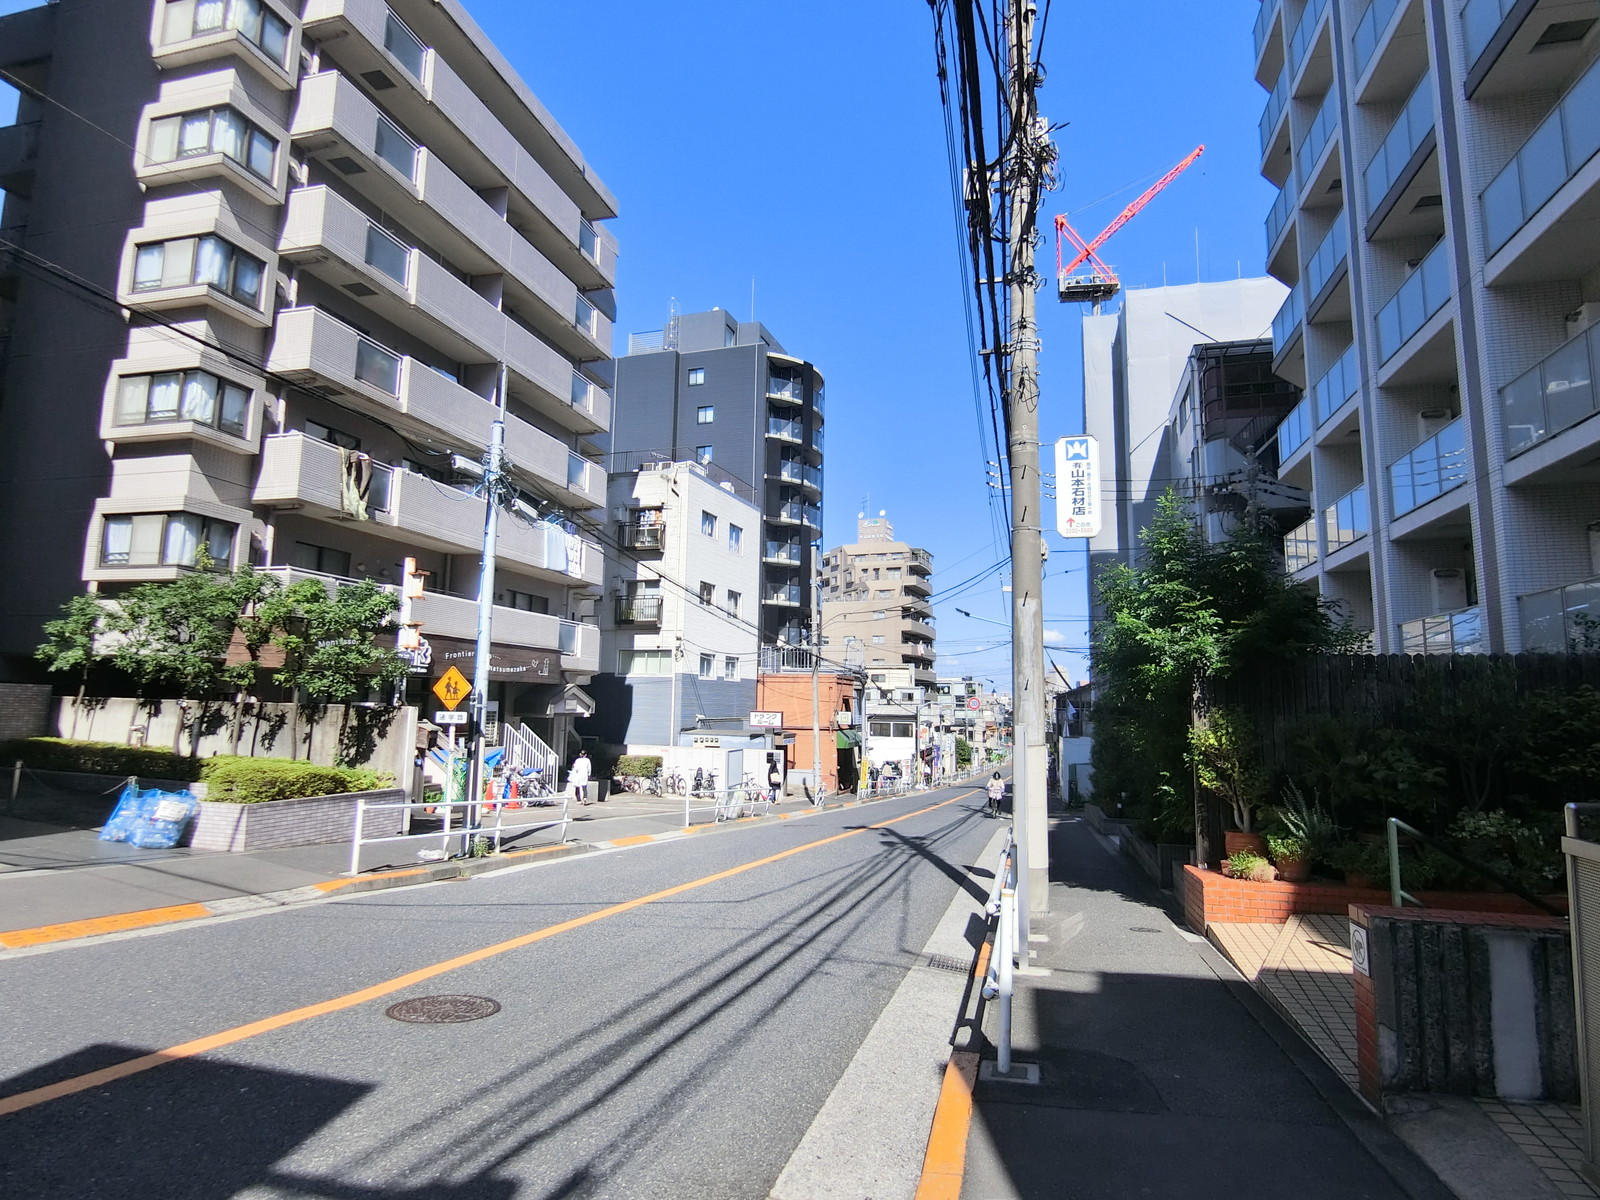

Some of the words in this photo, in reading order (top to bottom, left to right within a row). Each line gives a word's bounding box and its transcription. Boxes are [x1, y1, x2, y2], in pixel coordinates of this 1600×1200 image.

[445, 650, 475, 660] Frontier
[439, 713, 463, 721] 通学路
